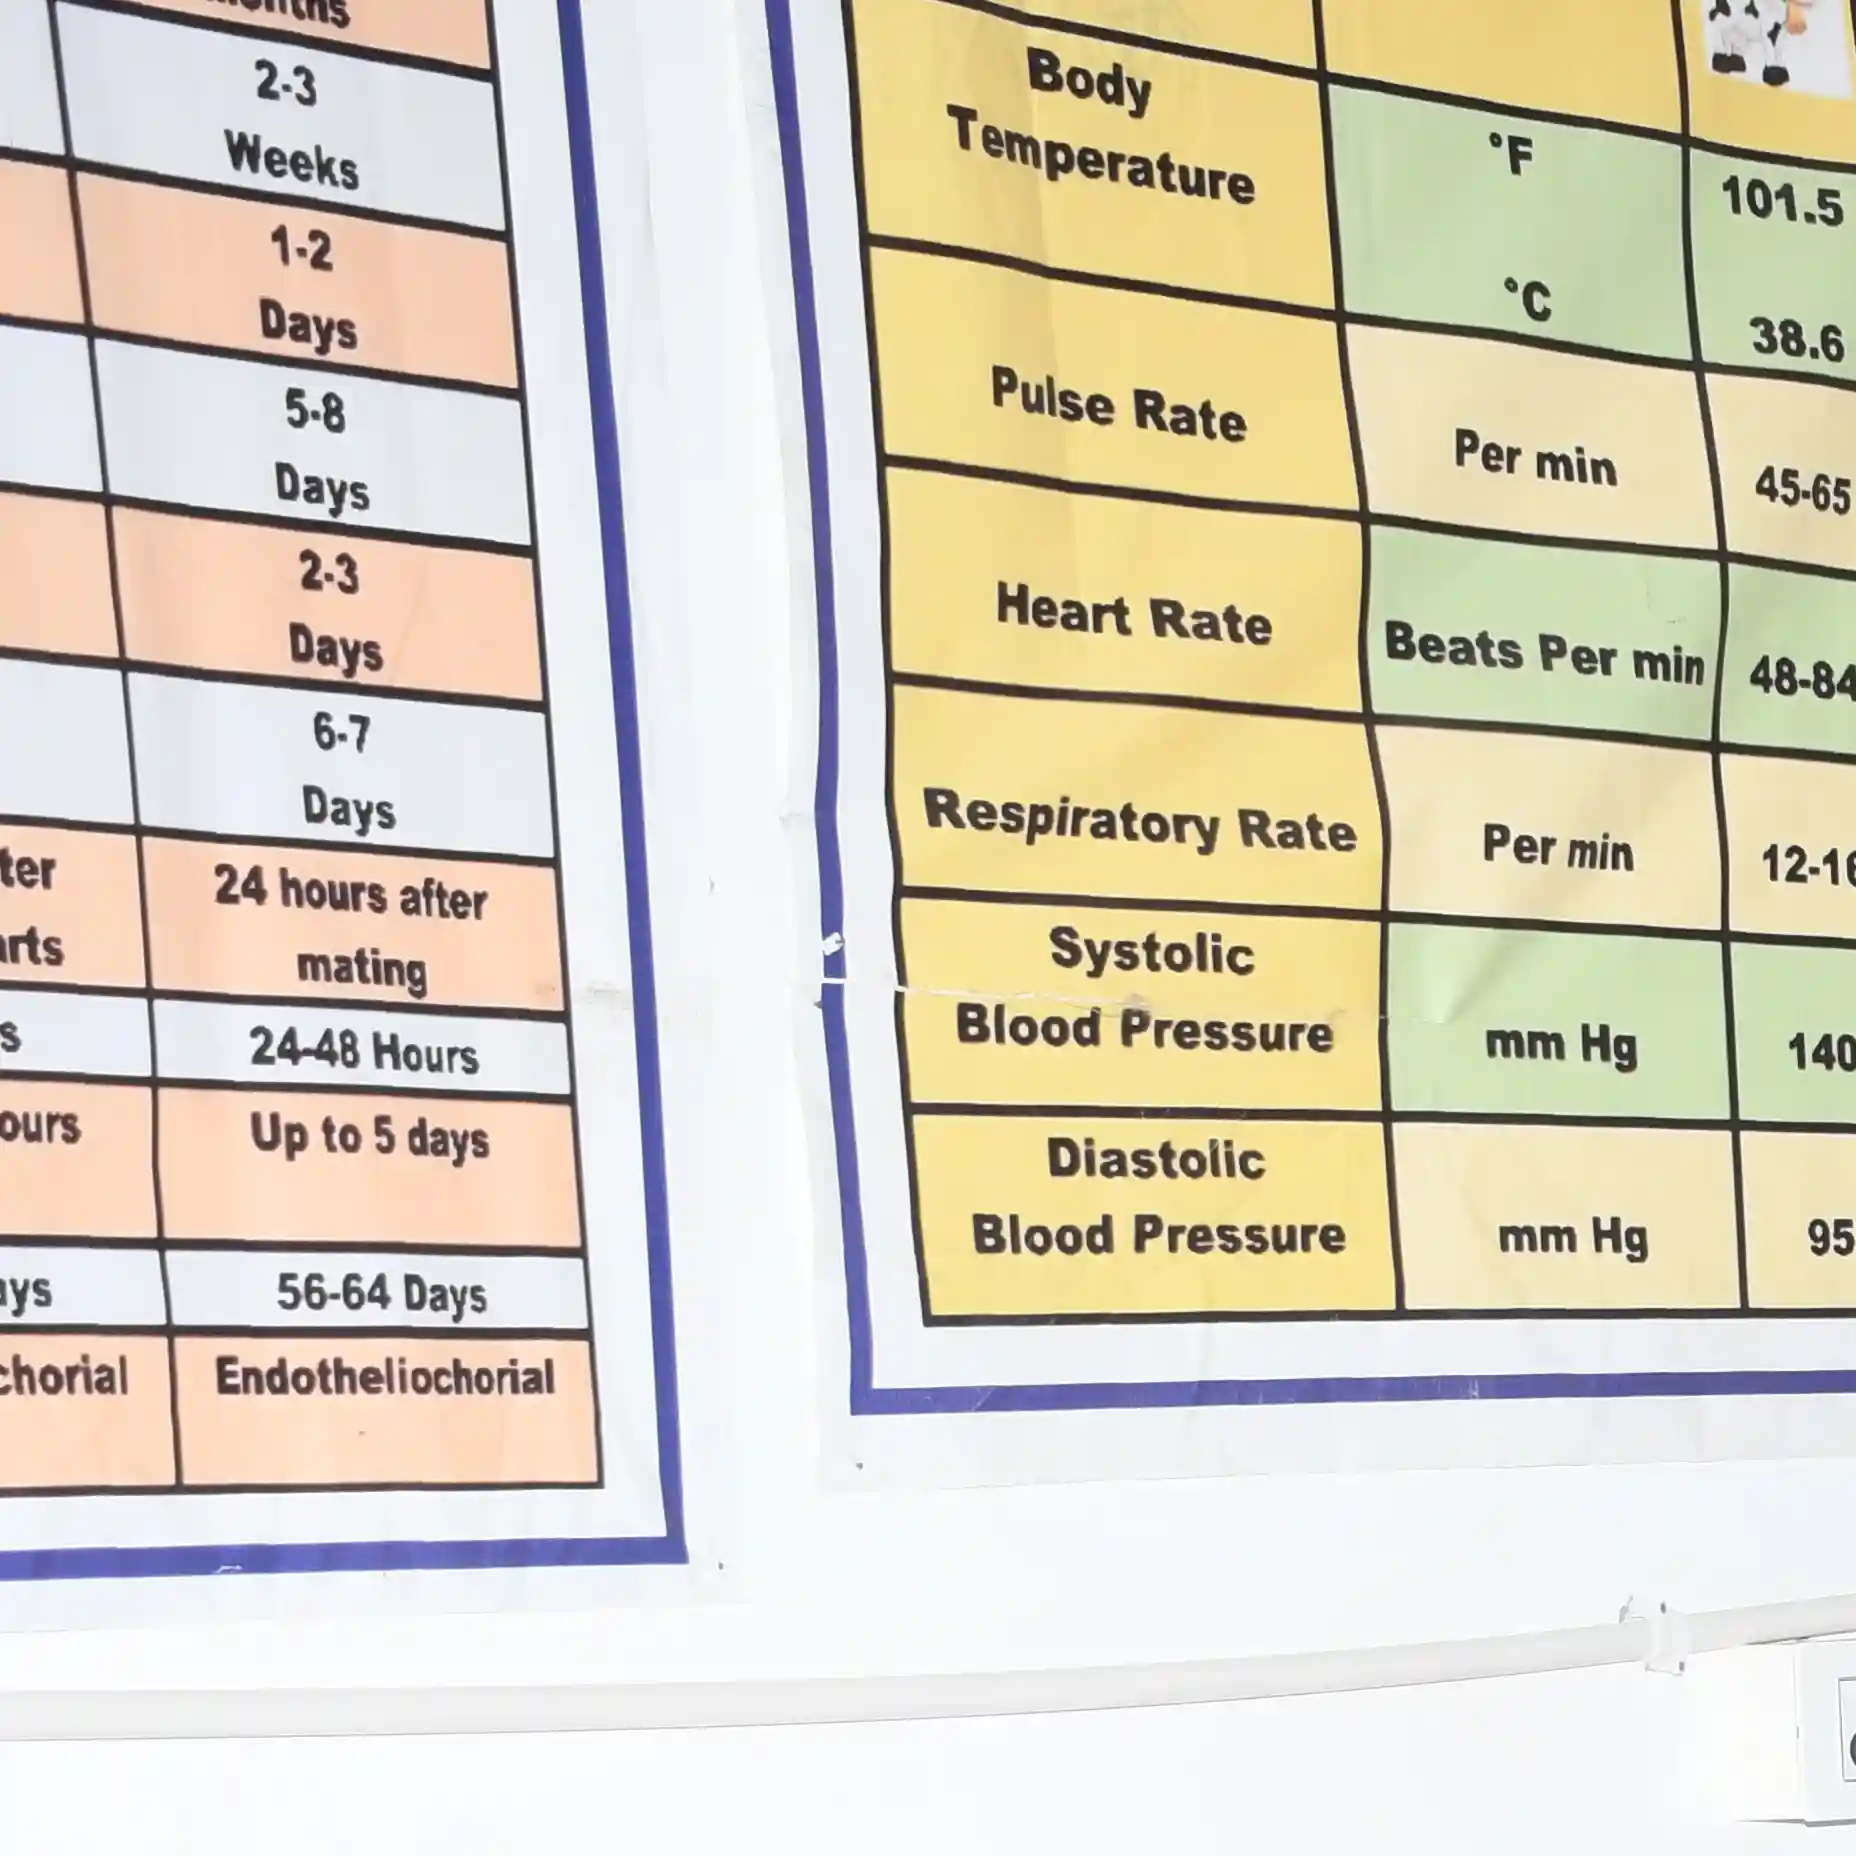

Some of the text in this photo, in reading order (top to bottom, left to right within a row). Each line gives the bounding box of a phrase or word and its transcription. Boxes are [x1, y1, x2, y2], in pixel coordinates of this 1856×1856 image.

[255, 59, 316, 106] 2-3
[1027, 47, 1151, 119] Body
[224, 129, 359, 190] Weeks
[947, 104, 1254, 204] Temperature
[1723, 175, 1843, 226] 101.5
[272, 225, 333, 271] 1-2
[260, 298, 357, 355] Days
[1750, 317, 1844, 362] 38.6
[286, 388, 345, 433] 5-8
[992, 365, 1247, 442] Pulse Rate
[1456, 428, 1617, 486] Per min
[276, 462, 369, 518] Days
[1756, 466, 1851, 515] 45-65
[300, 549, 358, 594] 2-3
[998, 581, 1272, 645] Heart Rate
[290, 622, 383, 679] Days
[1386, 620, 1704, 685] Beats Per min
[314, 712, 370, 752] 6-7
[303, 785, 395, 836] Days
[924, 788, 1357, 855] Respiratory Rate
[1484, 823, 1633, 871] Per min
[215, 864, 488, 920] 24 hours after
[298, 948, 427, 1000] mating
[1050, 926, 1254, 978] Systolic
[250, 1026, 479, 1074] 24-48 Hours
[957, 1003, 1333, 1052] Blood Pressure
[1486, 1024, 1637, 1073] mm Hg
[251, 1112, 489, 1167] Up to 5 days
[1048, 1137, 1265, 1180] Diastolic
[973, 1214, 1345, 1256] Blood Pressure
[1500, 1216, 1648, 1263] mm Hg
[1808, 1219, 1855, 1256] 95
[278, 1273, 486, 1323] 56-64 Days
[216, 1356, 554, 1395] Endotheliochorial
